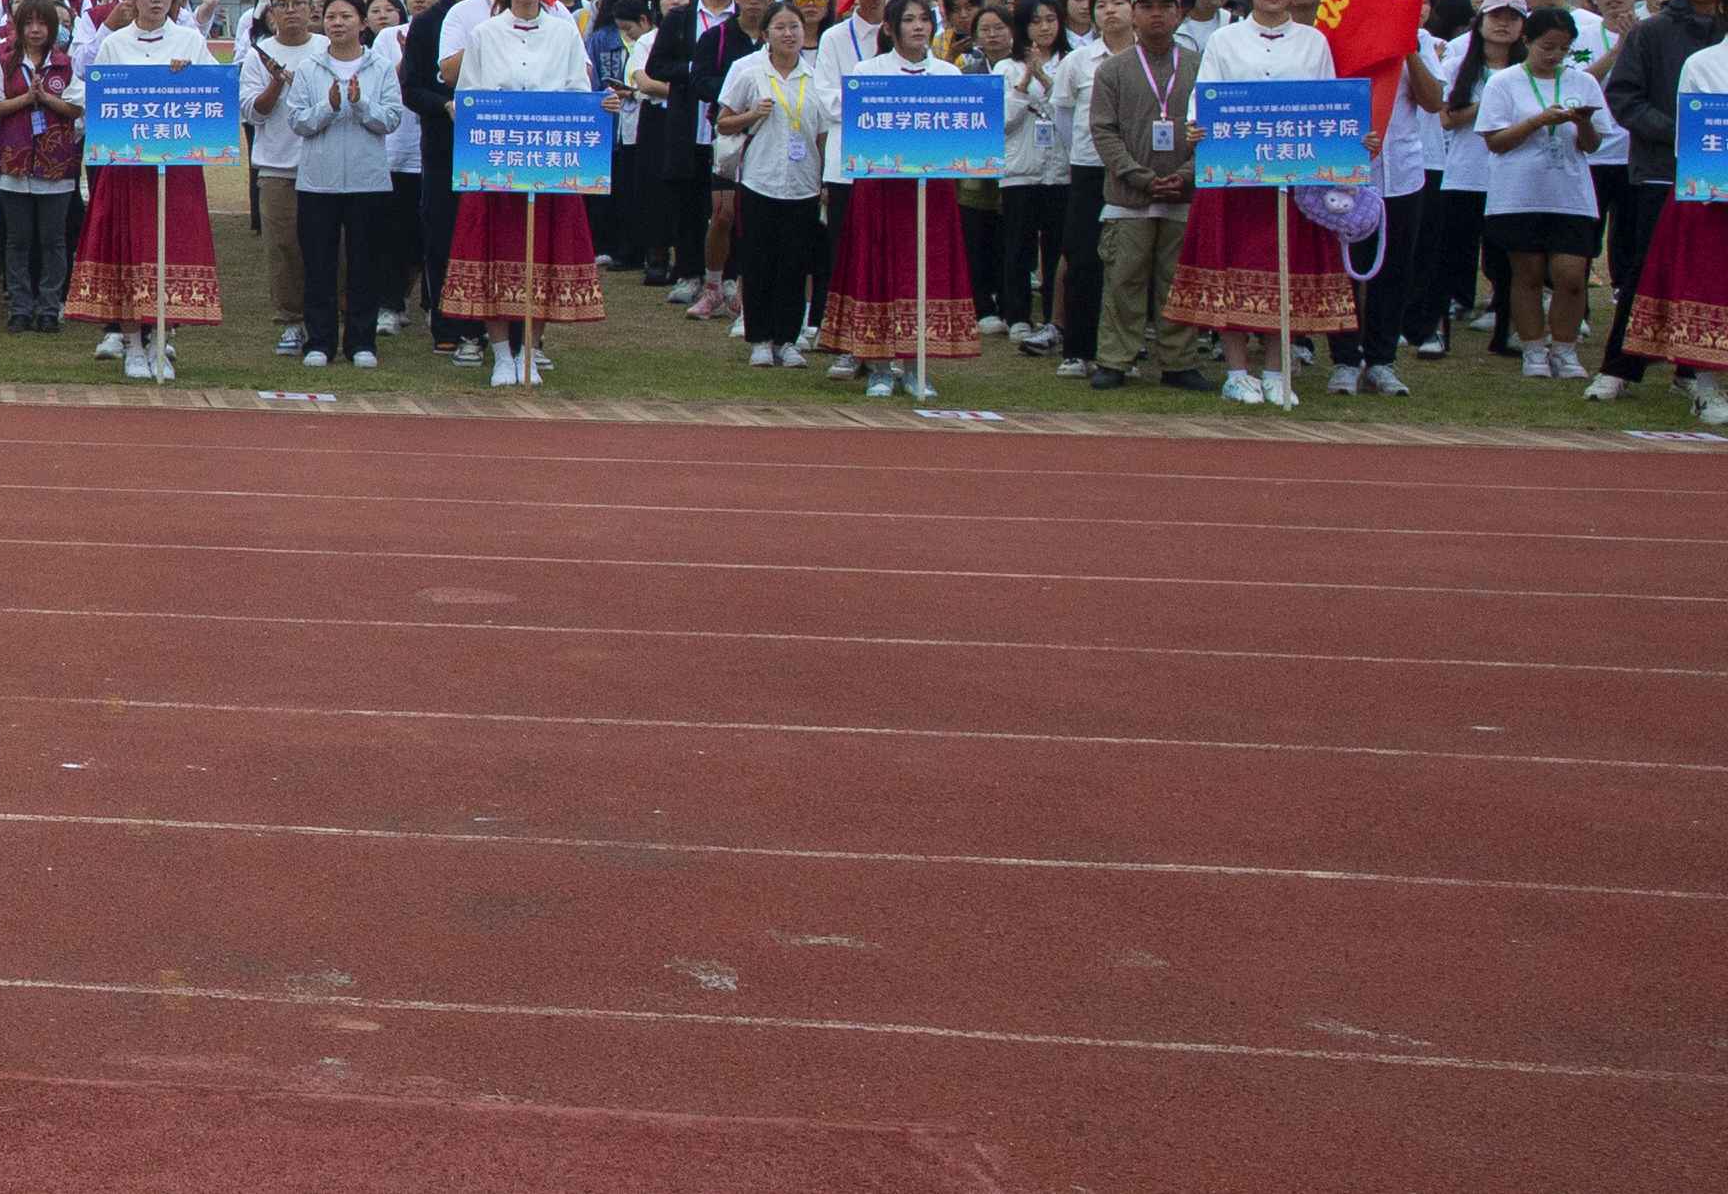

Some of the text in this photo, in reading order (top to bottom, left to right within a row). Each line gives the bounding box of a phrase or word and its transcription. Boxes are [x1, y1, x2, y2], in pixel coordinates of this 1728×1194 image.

[99, 101, 225, 120] 历史文化学院
[856, 111, 989, 131] 心理学院代表队
[1211, 119, 1361, 140] 数学与统计学院
[131, 122, 193, 141] 代表队
[469, 128, 602, 148] 地理与环境科学
[486, 149, 581, 168] 学院代表队
[1254, 142, 1317, 162] 代表队
